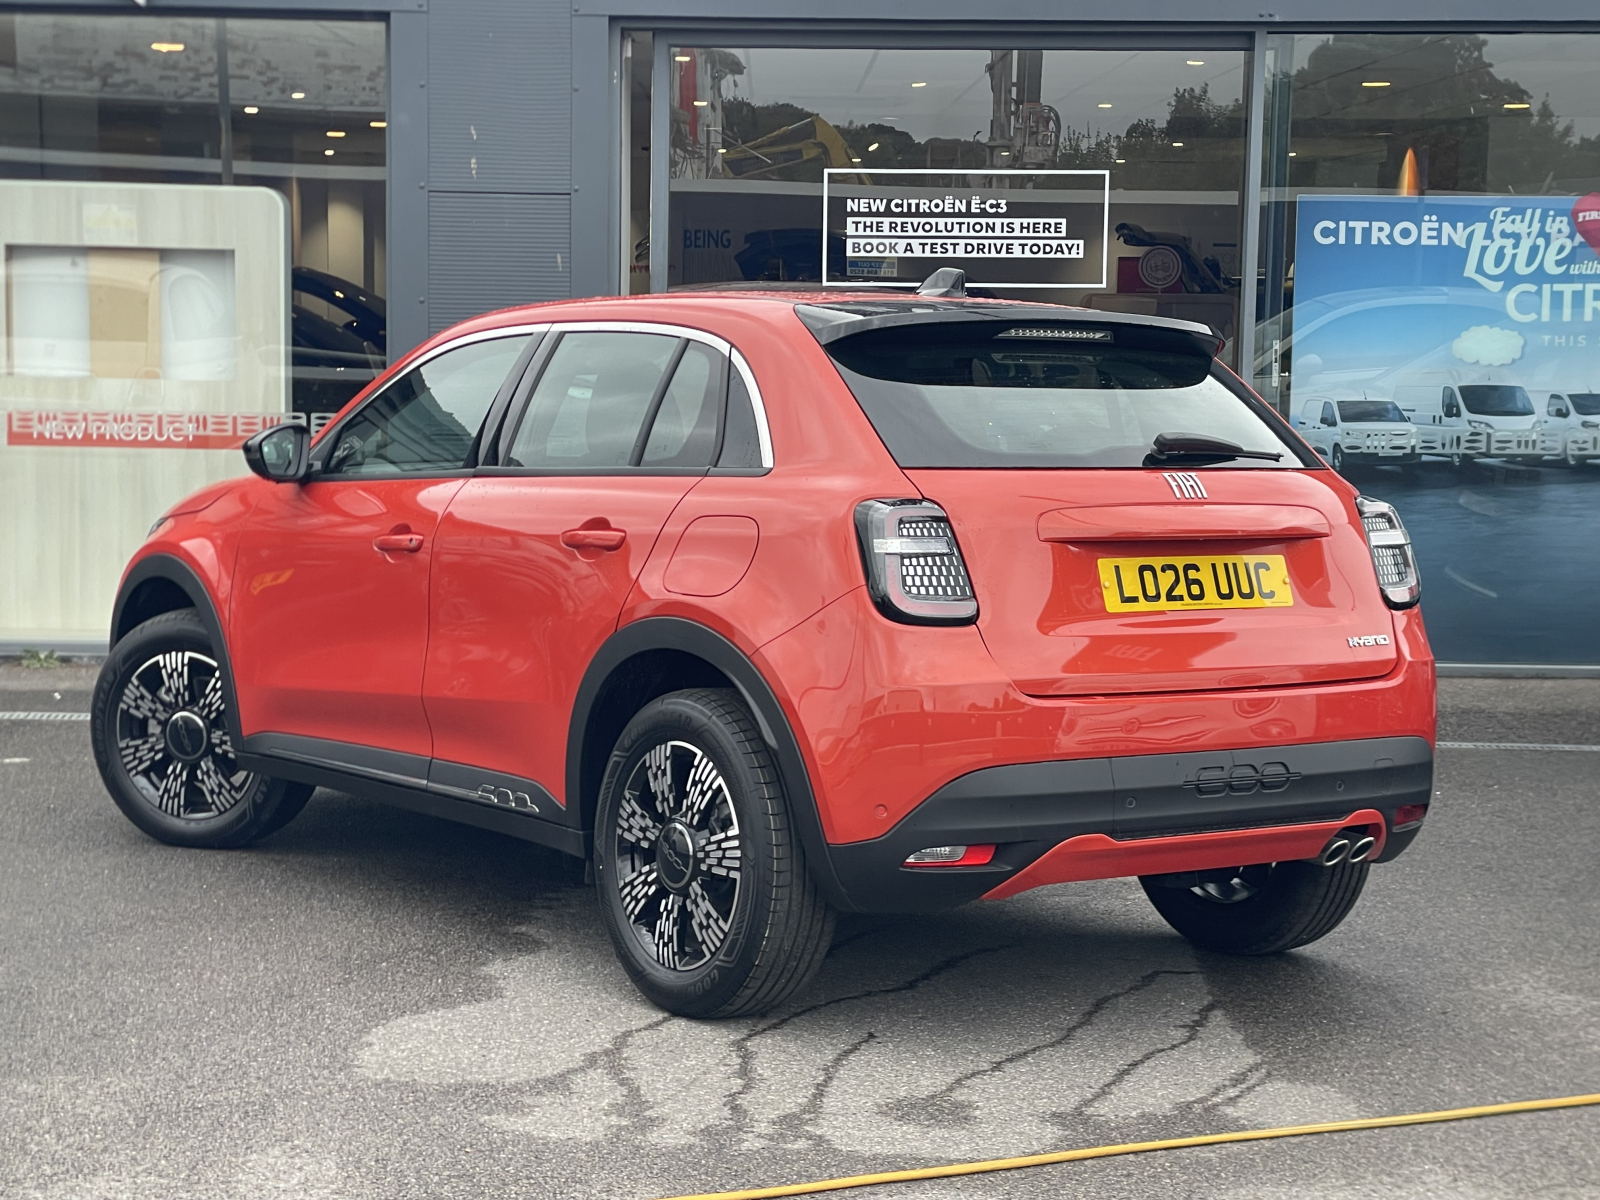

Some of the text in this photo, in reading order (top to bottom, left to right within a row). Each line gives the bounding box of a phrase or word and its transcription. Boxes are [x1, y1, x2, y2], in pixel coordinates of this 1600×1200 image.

[846, 195, 1008, 213] NEW CITROËN Ë-C3
[851, 220, 1063, 234] THE REVOLUTION IS HERE
[1313, 214, 1464, 247] CITROËN
[1489, 207, 1542, 234] Fall
[683, 229, 731, 249] BEING
[851, 241, 1080, 255] BOOK A TEST DRIVE TODAY!
[1460, 222, 1573, 292] Love
[1541, 335, 1587, 347] THIS
[33, 420, 198, 442] NEW PRODUCT
[1161, 472, 1208, 499] FIAT
[1211, 561, 1276, 600] UUC
